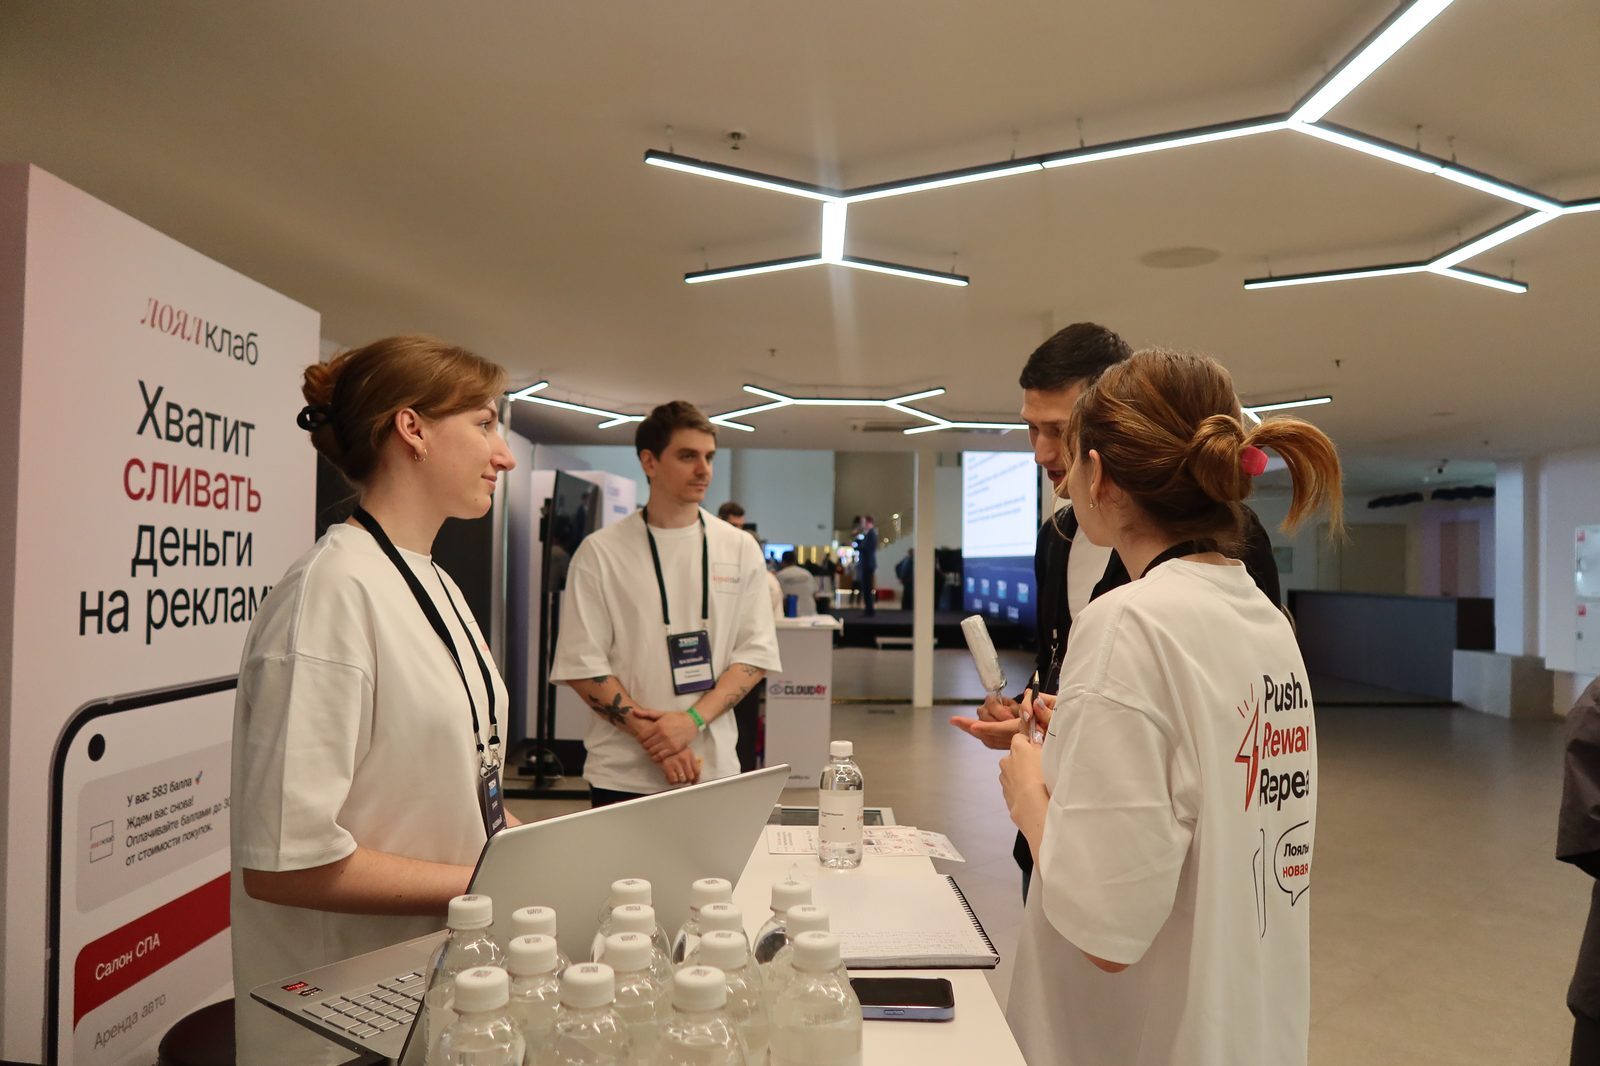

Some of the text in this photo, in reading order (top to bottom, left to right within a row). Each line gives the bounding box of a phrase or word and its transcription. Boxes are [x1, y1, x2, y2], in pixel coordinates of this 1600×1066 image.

[136, 379, 256, 457] Хватит
[123, 457, 262, 513] сливать
[131, 524, 253, 577] деньги
[79, 586, 273, 645] на реклам
[1263, 672, 1308, 714] Push.
[126, 778, 192, 808] У вас 583 балла
[126, 795, 194, 830] Ждем вас снова!
[126, 820, 180, 848] Оплачивайте
[180, 807, 212, 826] баллами
[212, 802, 222, 815] до
[125, 854, 136, 866] от
[137, 836, 181, 861] стоимости
[1282, 863, 1309, 878] новая
[95, 933, 161, 980] Салон СПА
[94, 993, 167, 1050] Аренда авто
